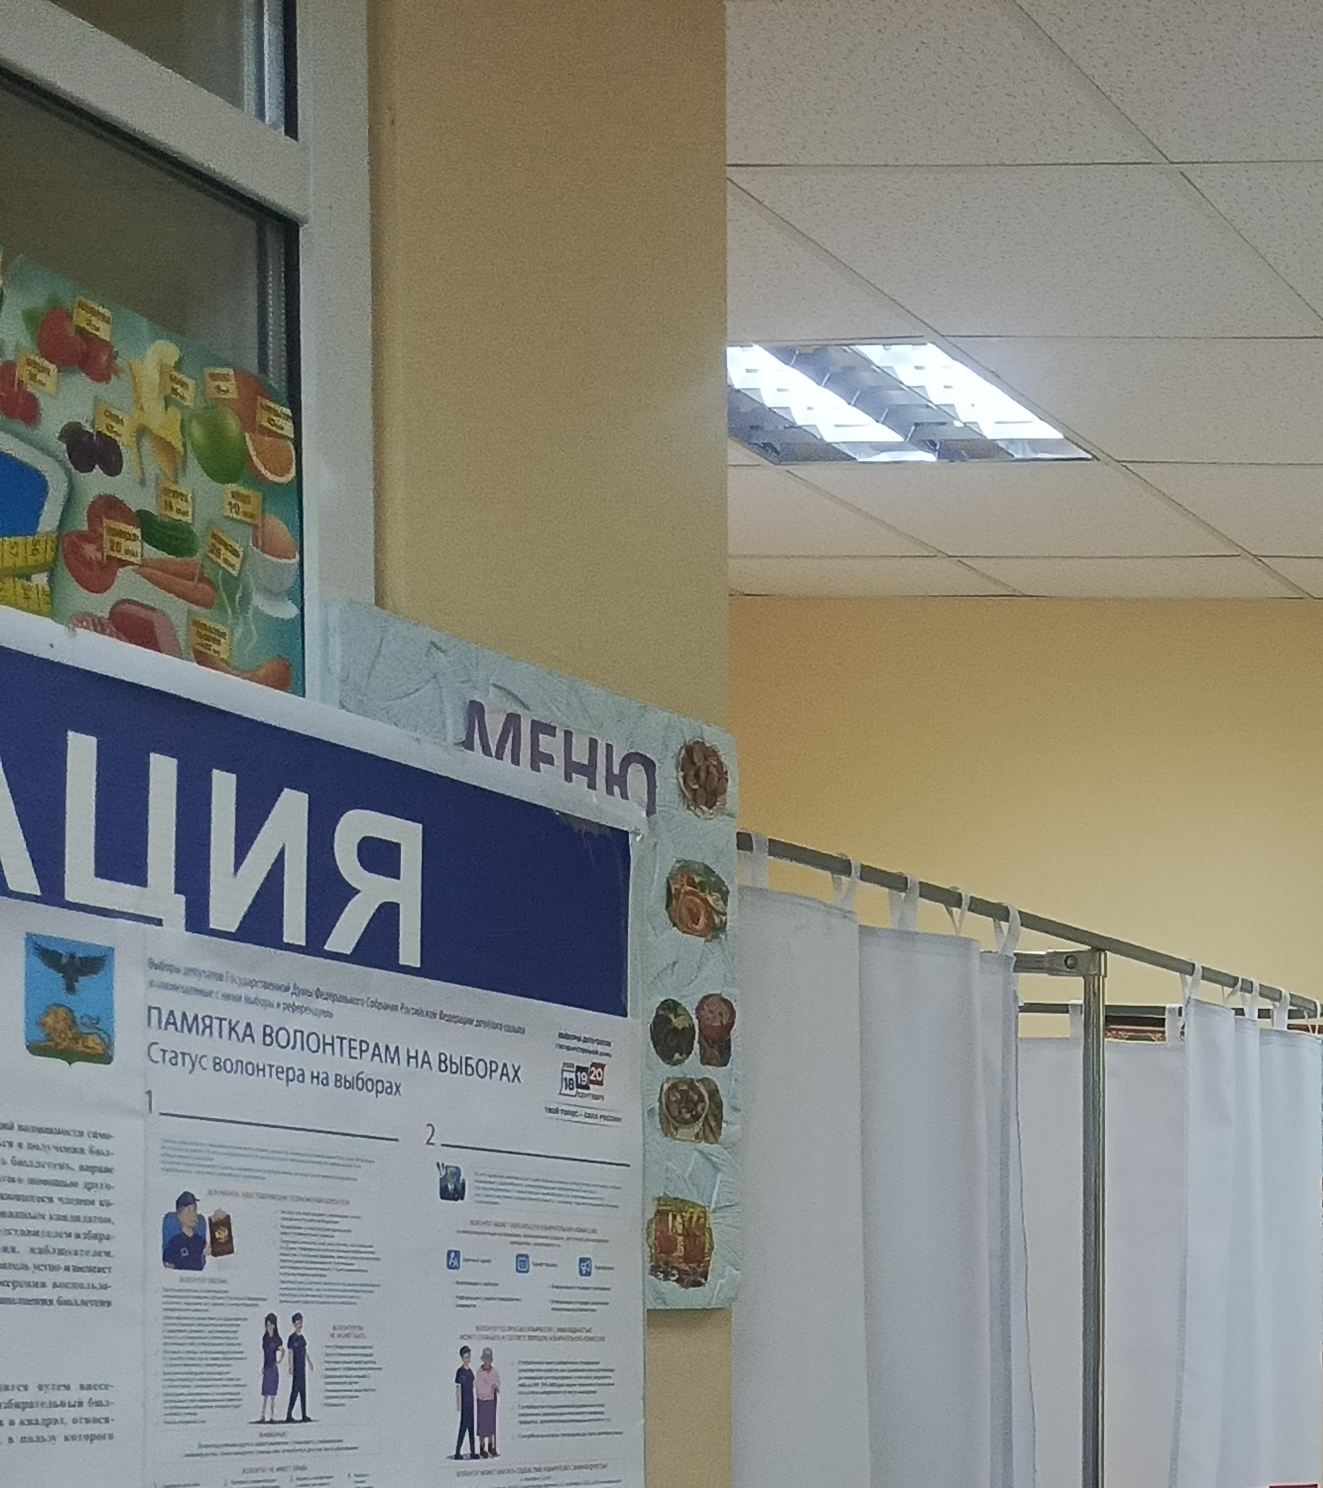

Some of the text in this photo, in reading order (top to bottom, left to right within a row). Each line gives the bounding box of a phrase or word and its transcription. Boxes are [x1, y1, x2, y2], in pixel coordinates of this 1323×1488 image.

[464, 699, 657, 818] МЕНЮ
[147, 1004, 522, 1084] ПАМЯТКА ВОЛОНТЕРАМ НА ВЫБОРАХ
[147, 1040, 402, 1098] Статус волонтера на выборах
[563, 1066, 604, 1091] 18 19 20
[145, 1089, 153, 1114] 1
[424, 1122, 436, 1146] 2
